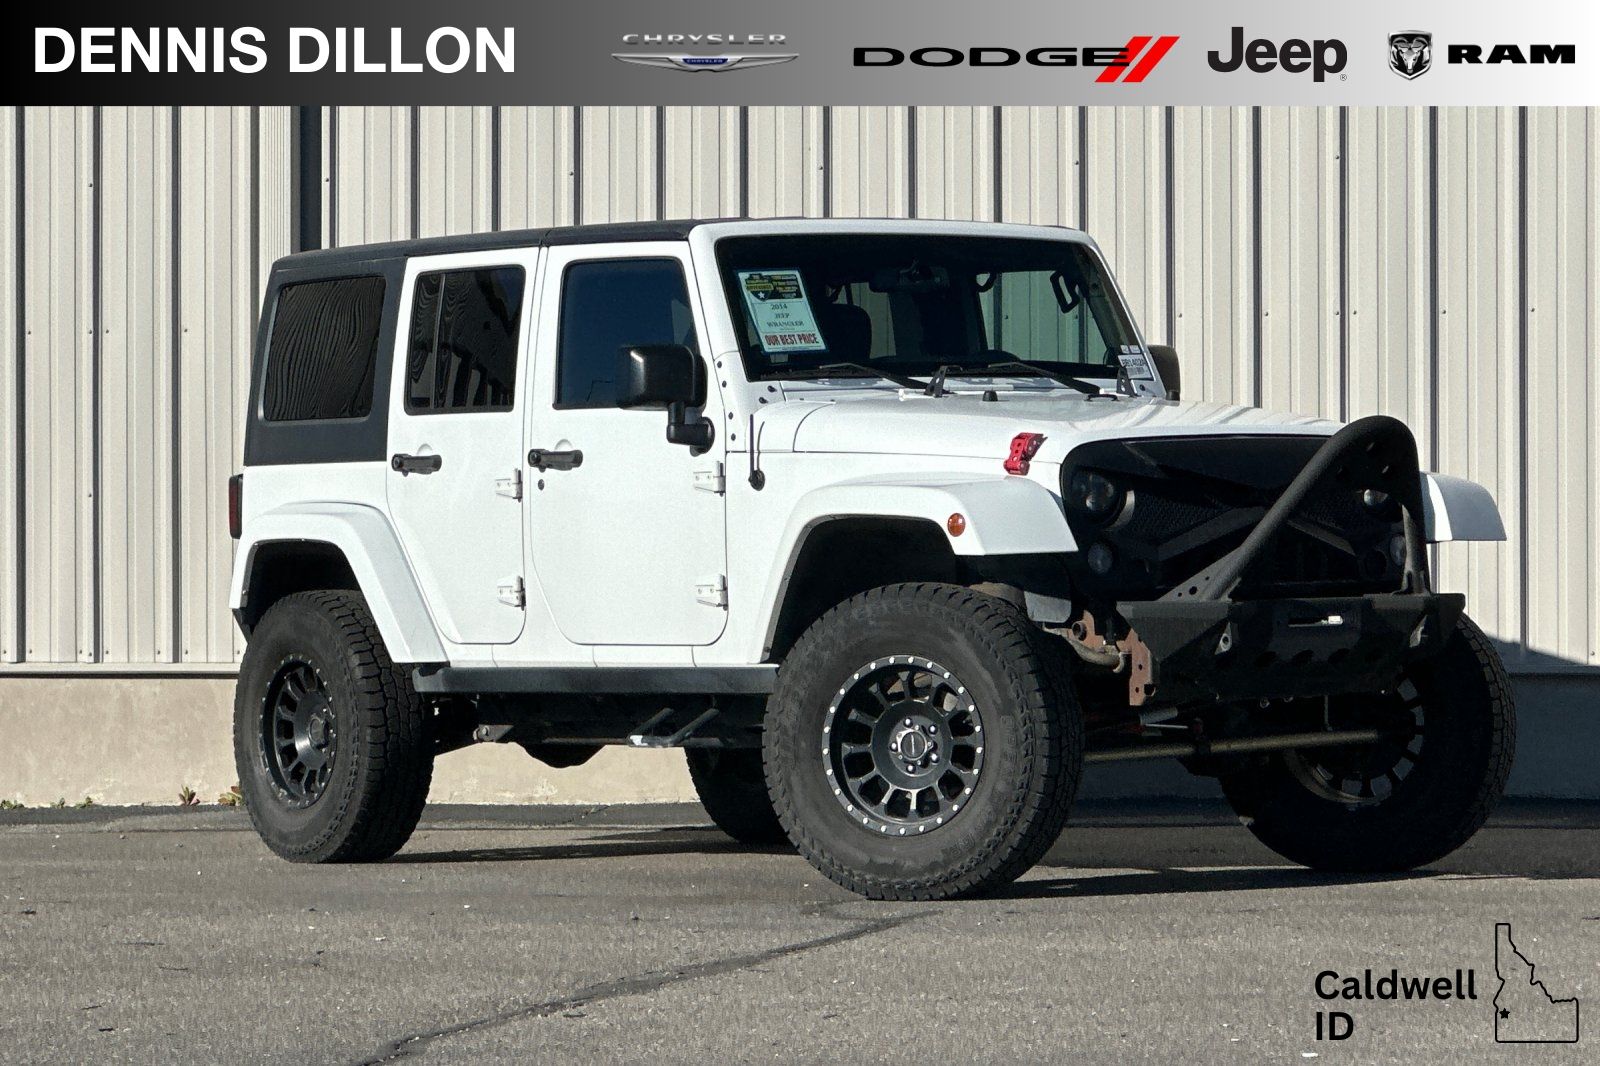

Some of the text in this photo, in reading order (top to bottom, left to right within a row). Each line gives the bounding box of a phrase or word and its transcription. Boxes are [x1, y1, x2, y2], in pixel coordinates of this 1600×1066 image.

[766, 320, 804, 328] WRANGLER
[765, 333, 819, 345] OUR BEST PRICE
